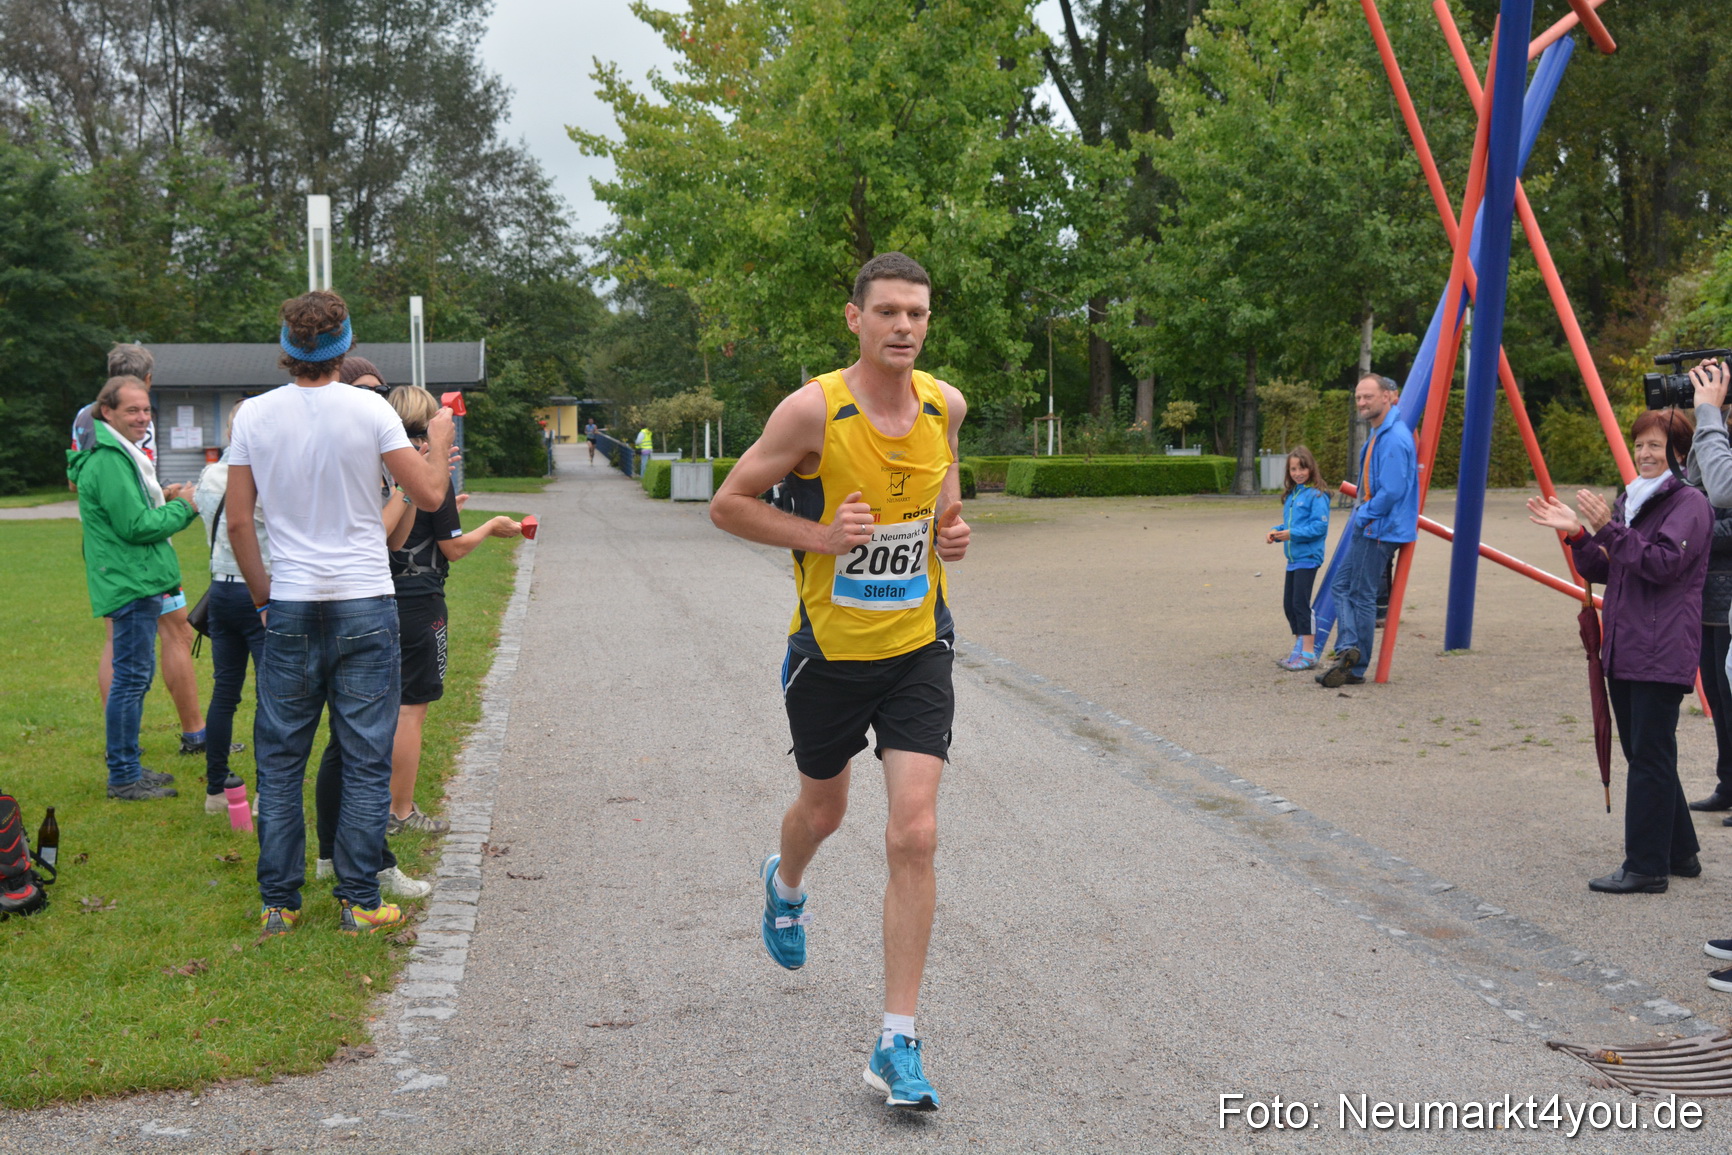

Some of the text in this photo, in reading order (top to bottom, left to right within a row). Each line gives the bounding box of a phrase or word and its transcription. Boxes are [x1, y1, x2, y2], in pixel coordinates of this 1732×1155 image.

[880, 529, 920, 542] Neumarkt
[846, 541, 923, 575] 2062
[864, 584, 906, 598] Stefan
